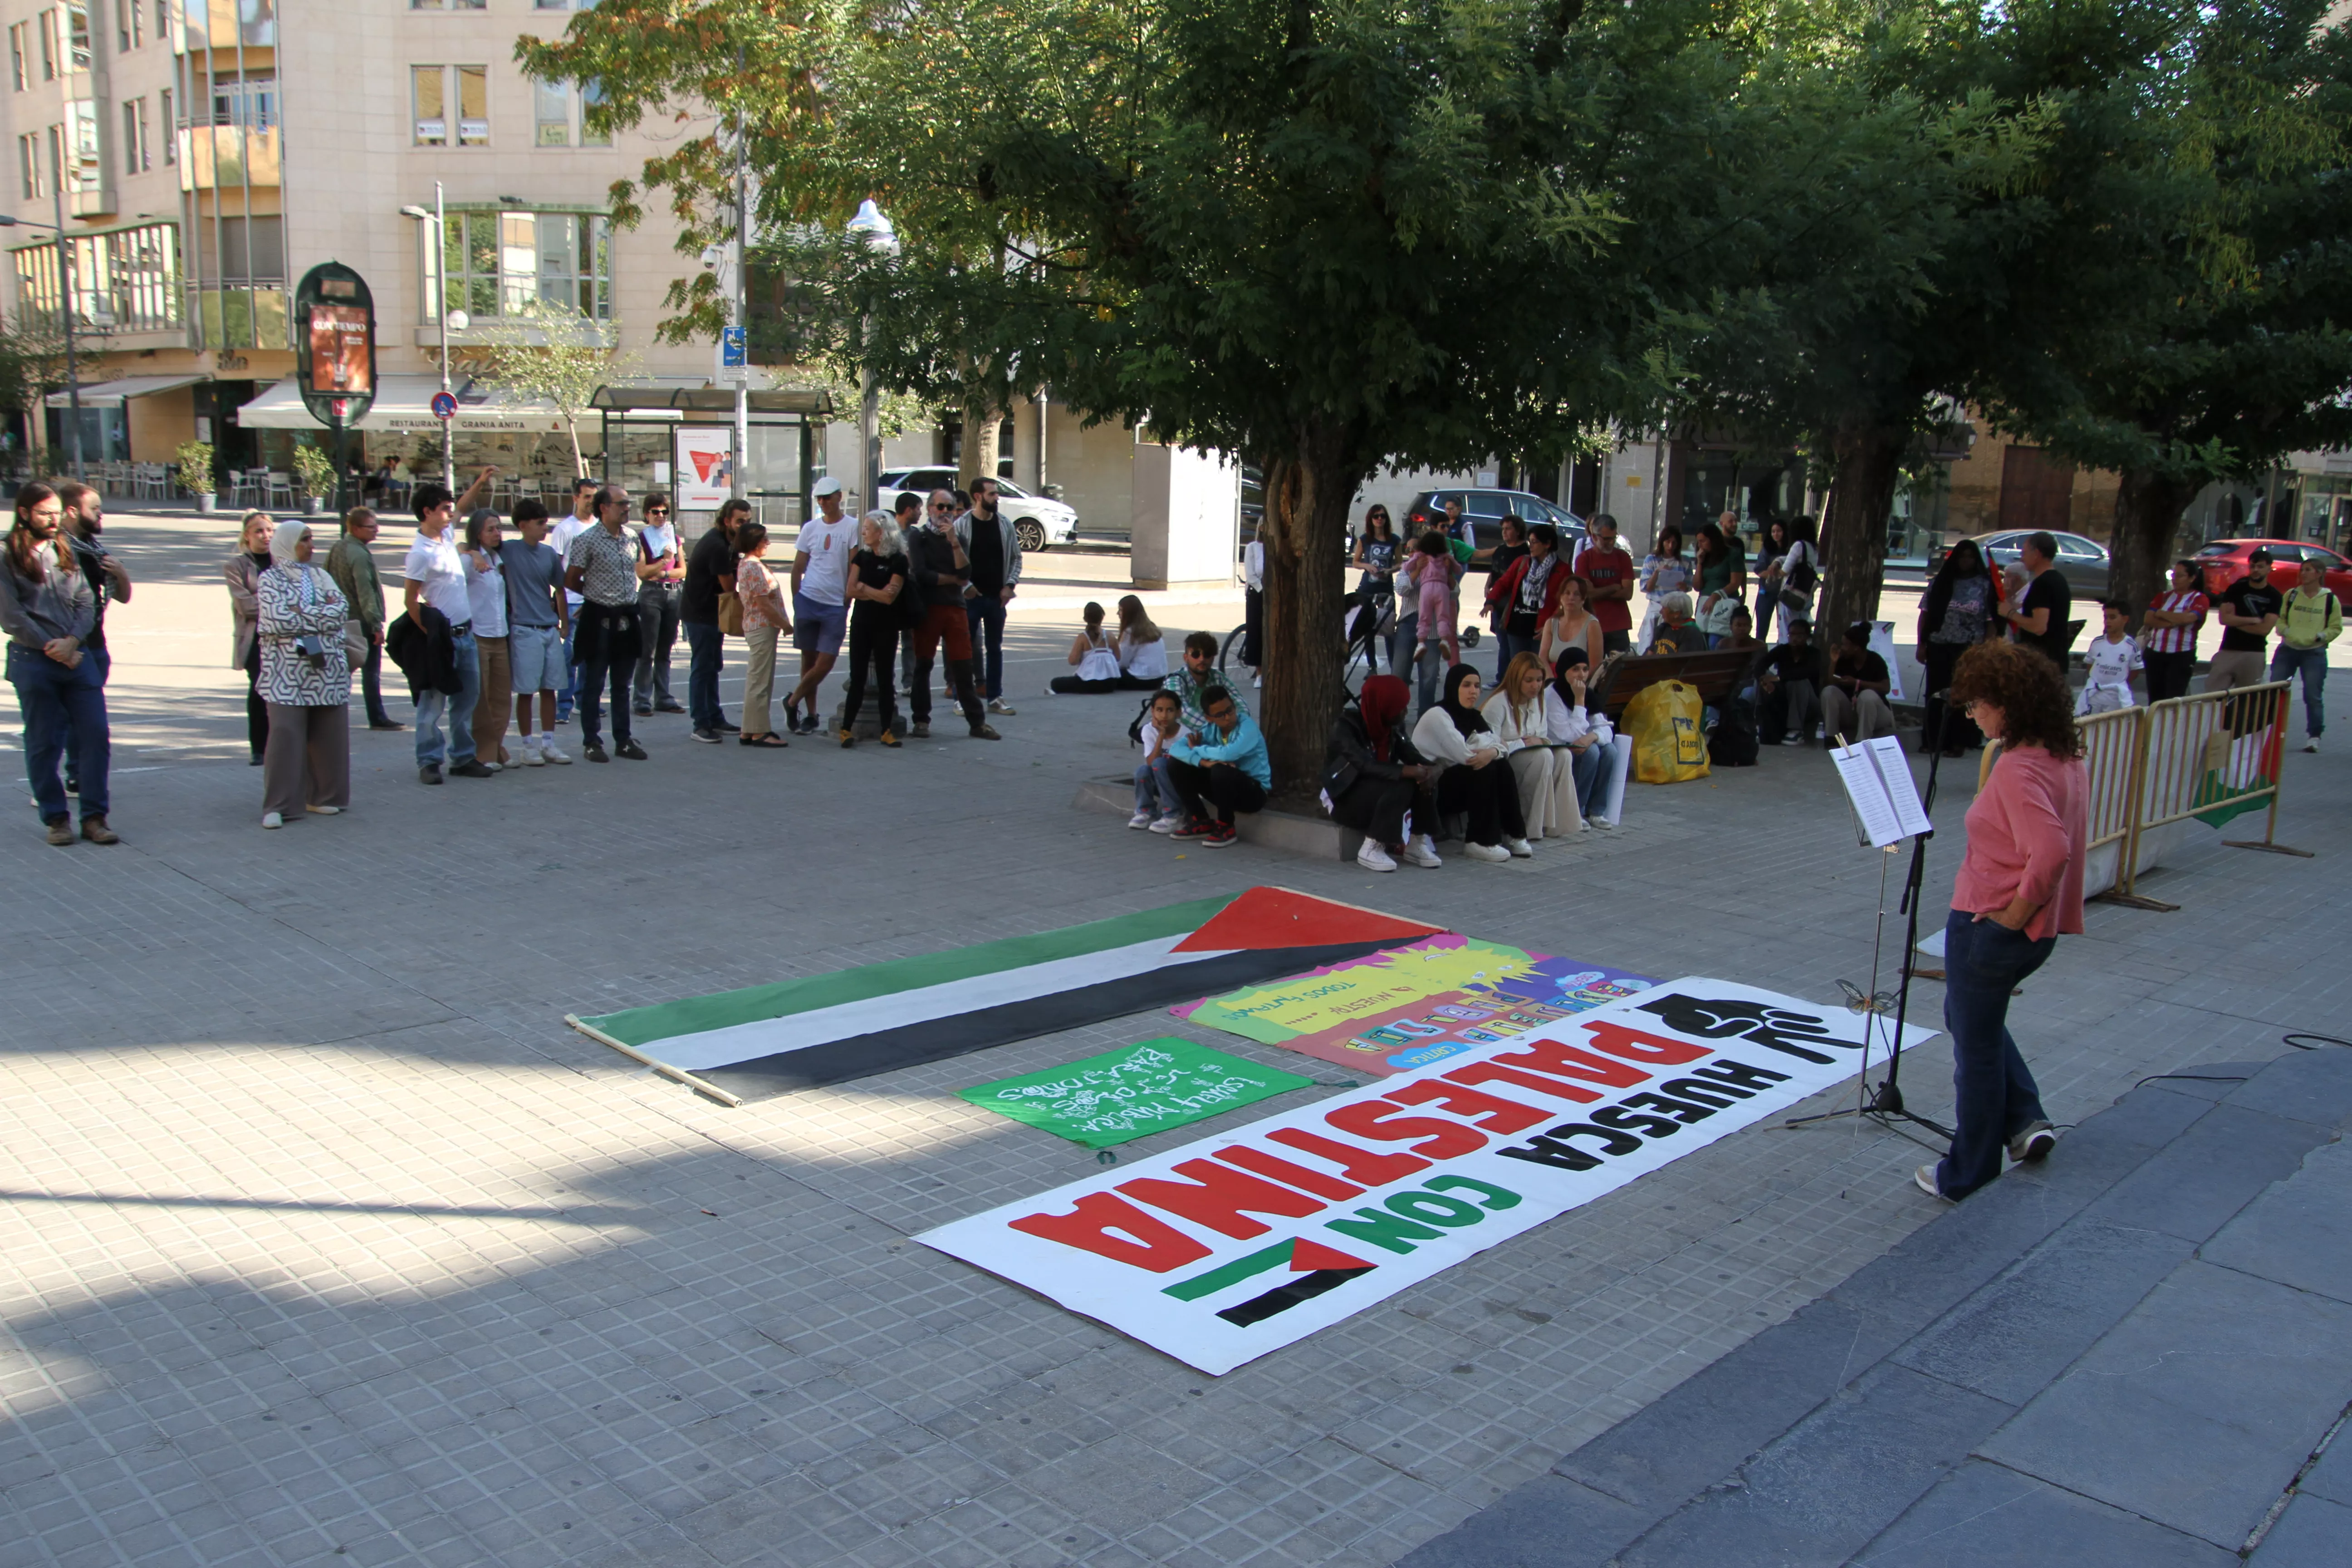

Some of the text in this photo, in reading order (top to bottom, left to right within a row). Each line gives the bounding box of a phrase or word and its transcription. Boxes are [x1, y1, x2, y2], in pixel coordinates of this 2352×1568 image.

[1303, 981, 1357, 999] TODOS
[1107, 1048, 1163, 1078] PARA
[1404, 1044, 1457, 1064] CRÍTICA
[1008, 1020, 1715, 1273] PALESTINA
[1323, 1059, 1793, 1254] HUESCA CON
